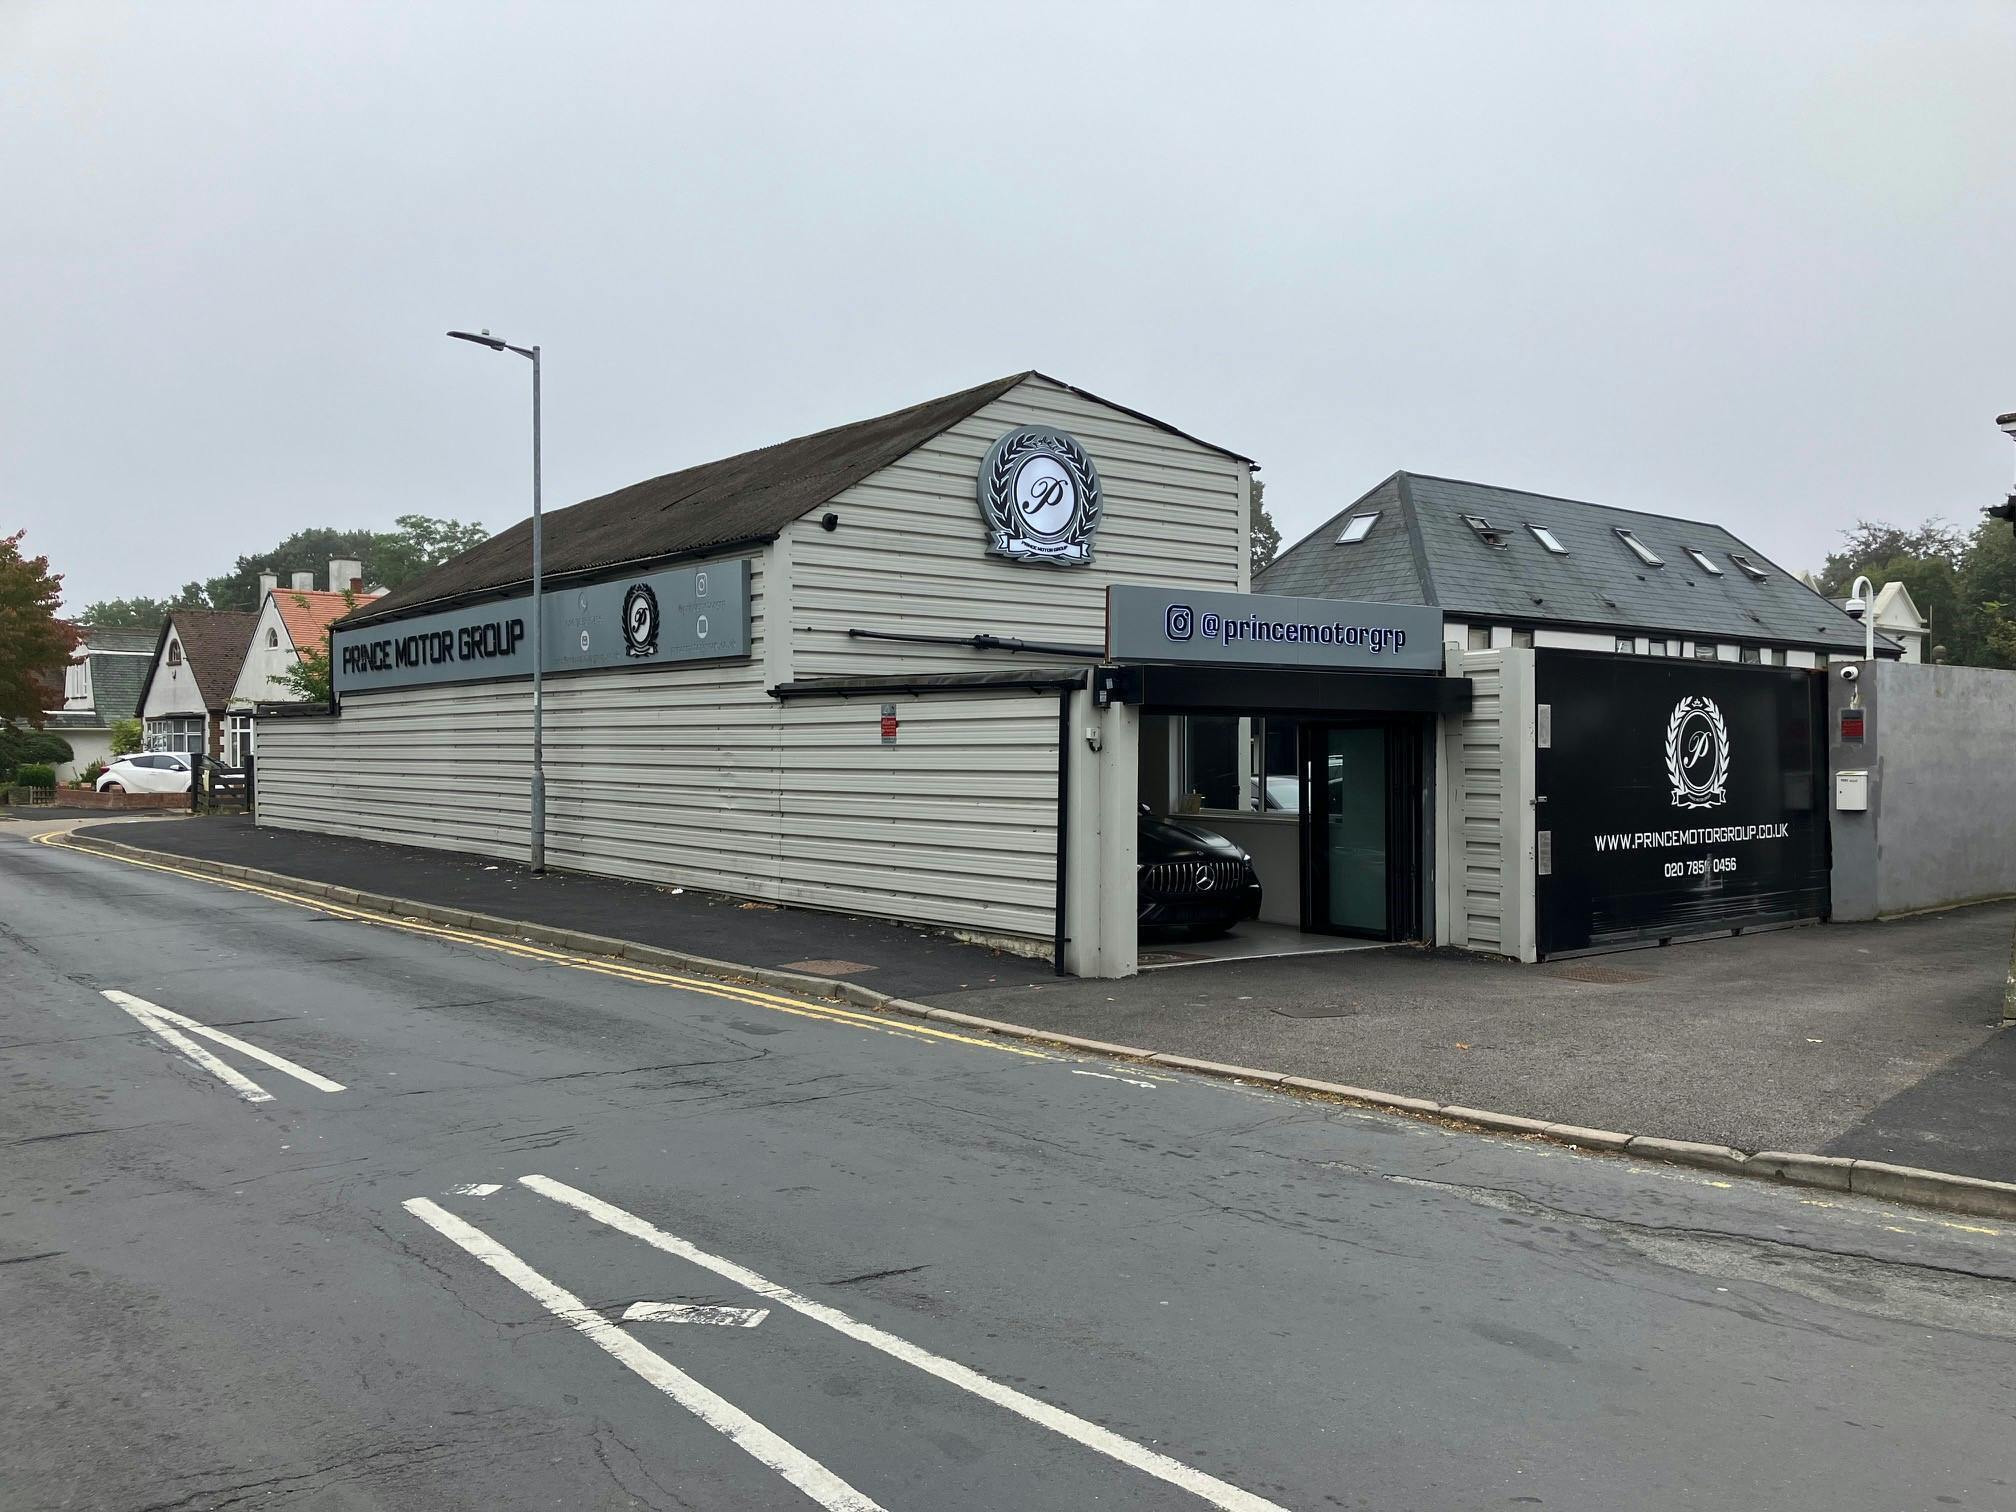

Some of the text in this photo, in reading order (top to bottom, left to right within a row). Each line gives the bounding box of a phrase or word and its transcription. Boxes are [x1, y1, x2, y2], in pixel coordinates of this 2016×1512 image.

[1022, 476, 1068, 514] P
[343, 618, 524, 674] PRINCE MOTOR GROUP
[1201, 613, 1406, 654] @princemotorgrp
[1684, 731, 1712, 768] P
[1594, 823, 1789, 851] WWW.PRINCEMOTORGROUP.CO.UK
[1664, 863, 1684, 877] 020
[1713, 857, 1737, 873] 0456
